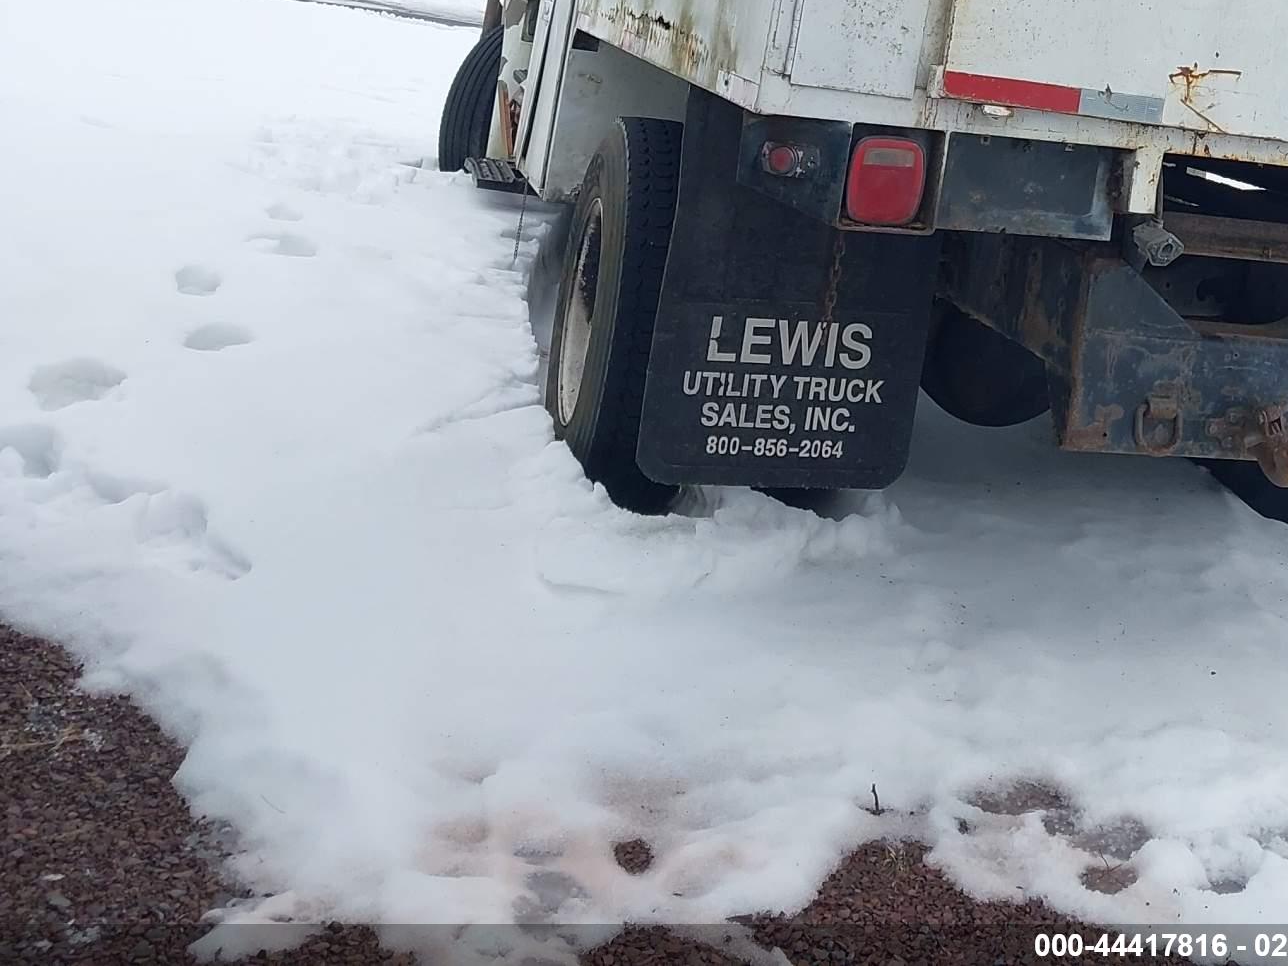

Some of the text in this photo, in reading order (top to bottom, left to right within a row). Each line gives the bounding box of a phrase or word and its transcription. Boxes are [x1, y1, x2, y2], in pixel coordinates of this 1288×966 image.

[707, 316, 873, 370] LEWIS
[683, 370, 885, 403] UTILITY TRUCK
[701, 402, 855, 434] SALES, INC.
[706, 435, 844, 459] 800-856-2064
